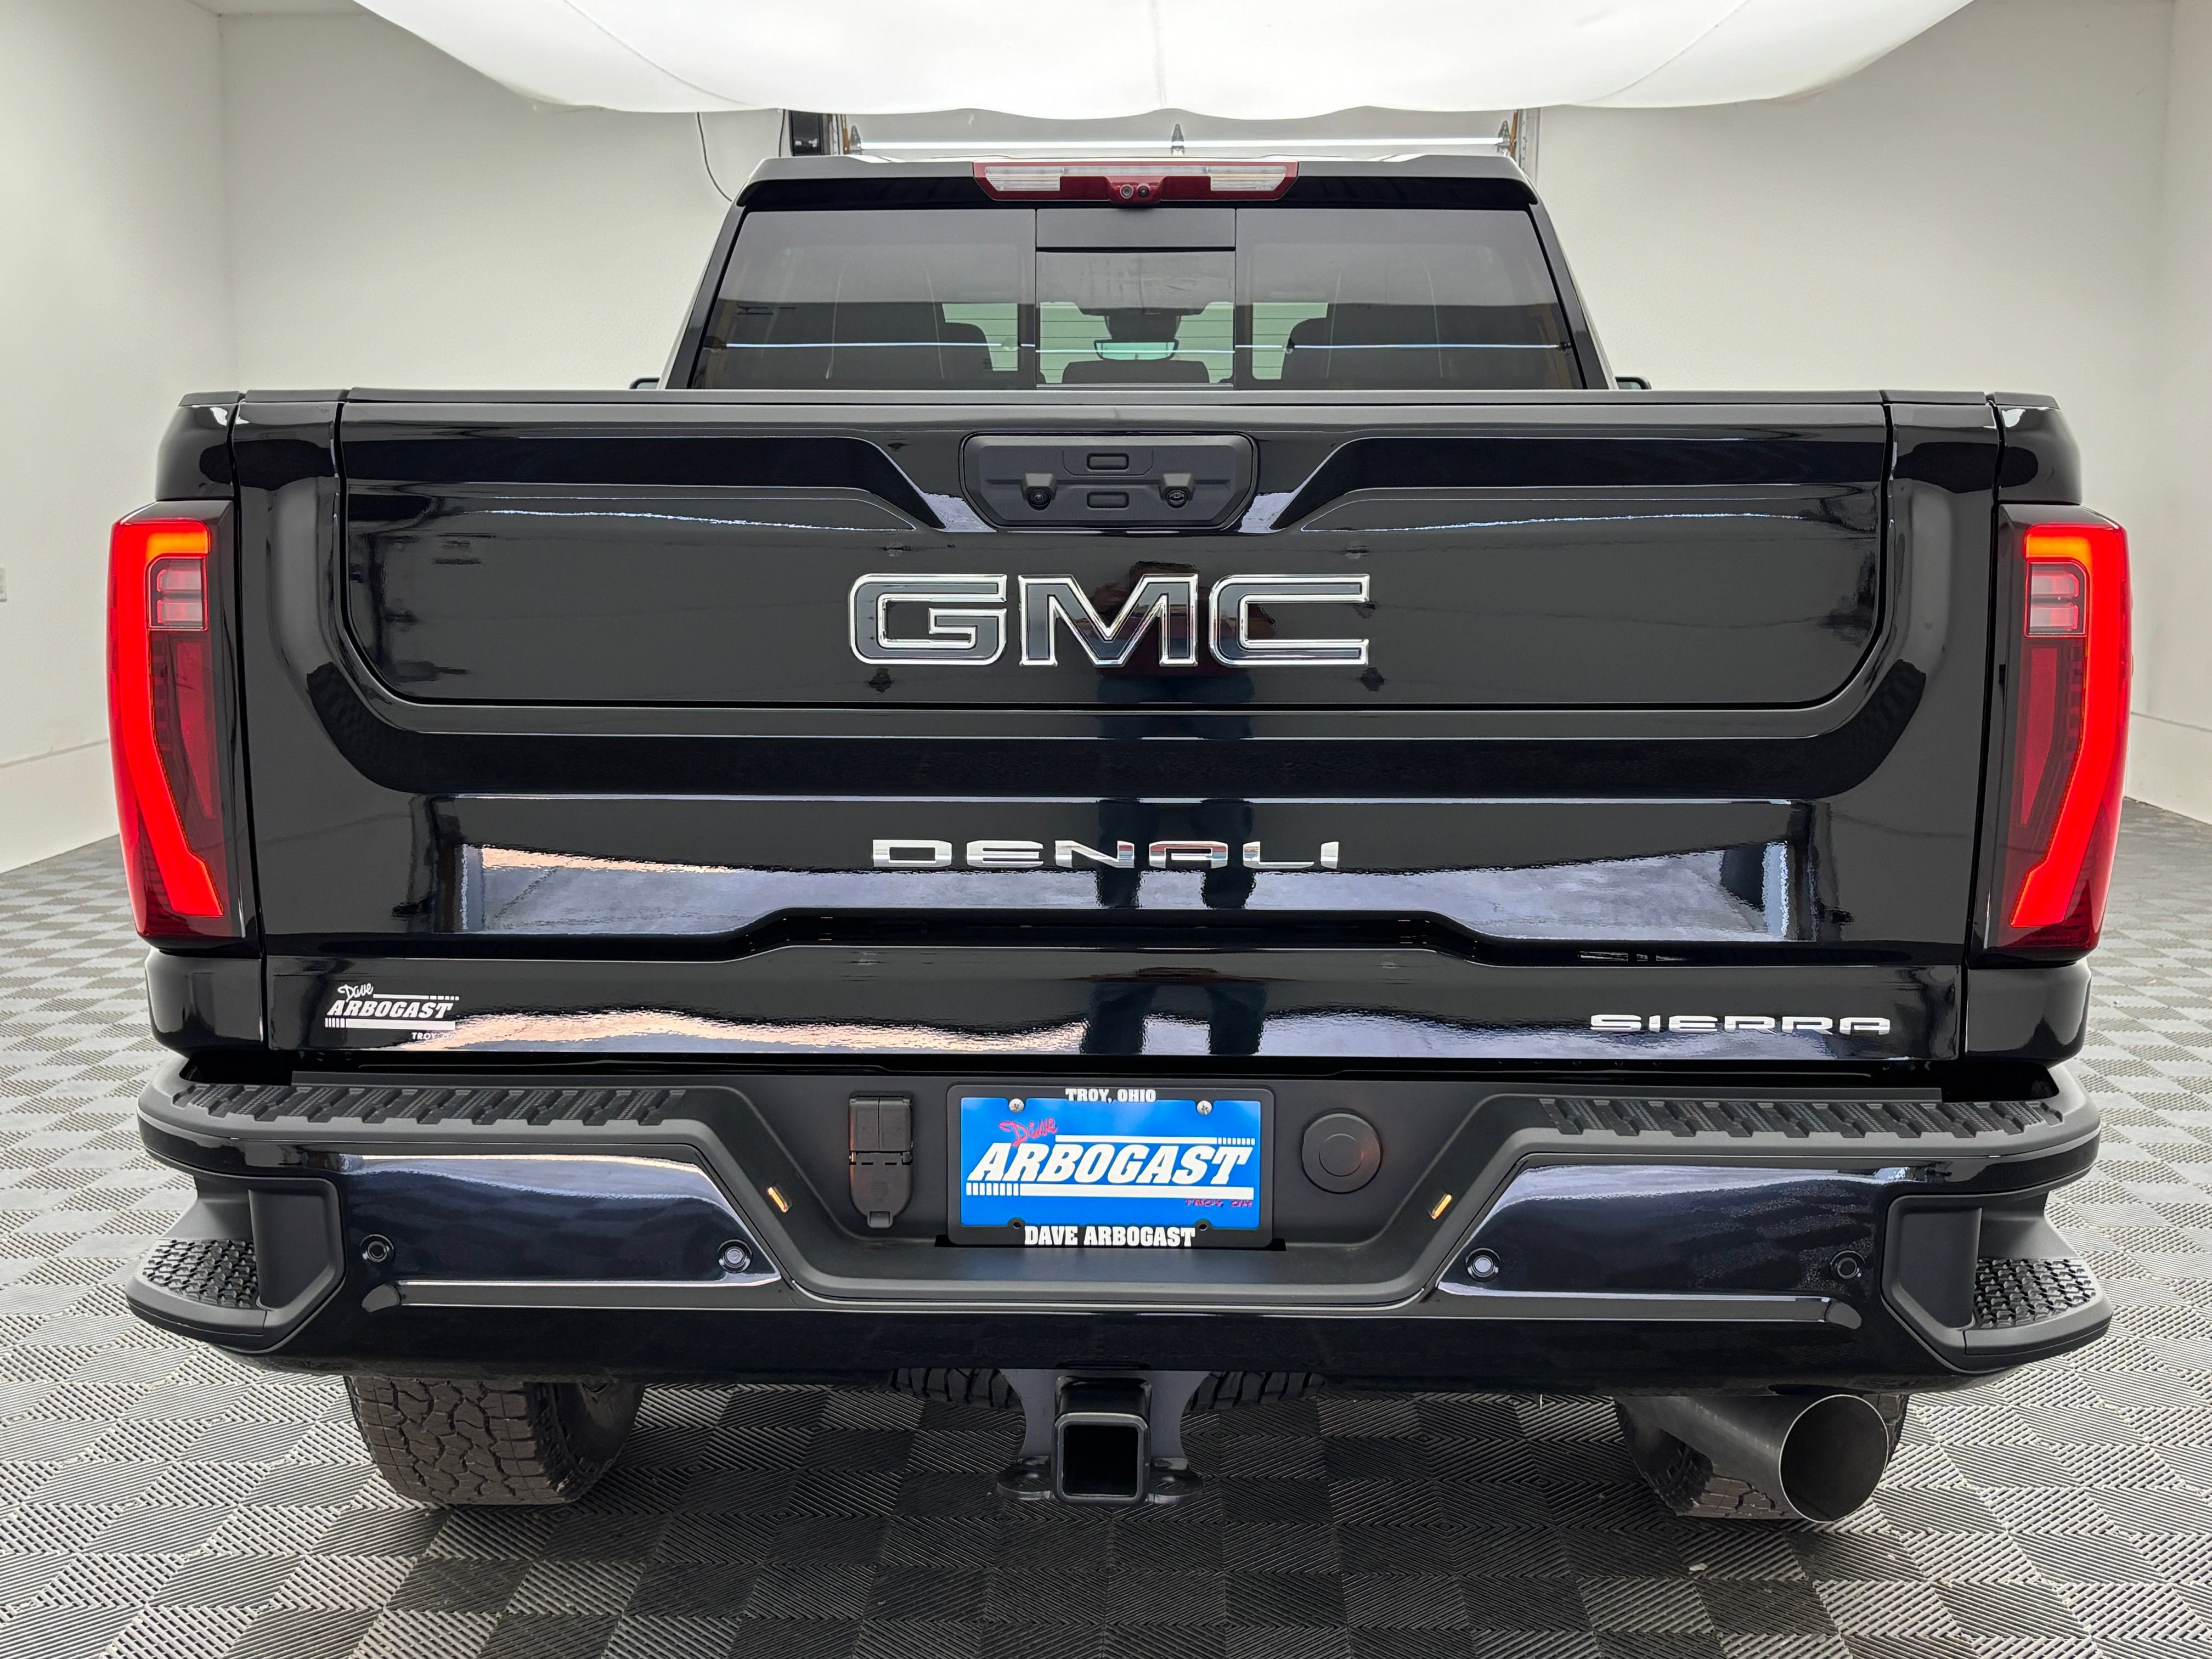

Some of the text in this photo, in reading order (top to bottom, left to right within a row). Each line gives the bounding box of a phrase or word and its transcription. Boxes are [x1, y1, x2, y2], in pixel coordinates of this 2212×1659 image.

[848, 573, 1370, 667] GMC
[872, 840, 1339, 868] DENALI
[337, 983, 374, 1002] Dave
[326, 1000, 454, 1018] ARBOGAST
[1590, 1014, 1891, 1035] SIERRA
[1065, 1088, 1156, 1104] TROY, OHIO
[967, 1142, 1253, 1185] ARBOGAST
[1024, 1226, 1195, 1247] DAVE ARBOGAST
